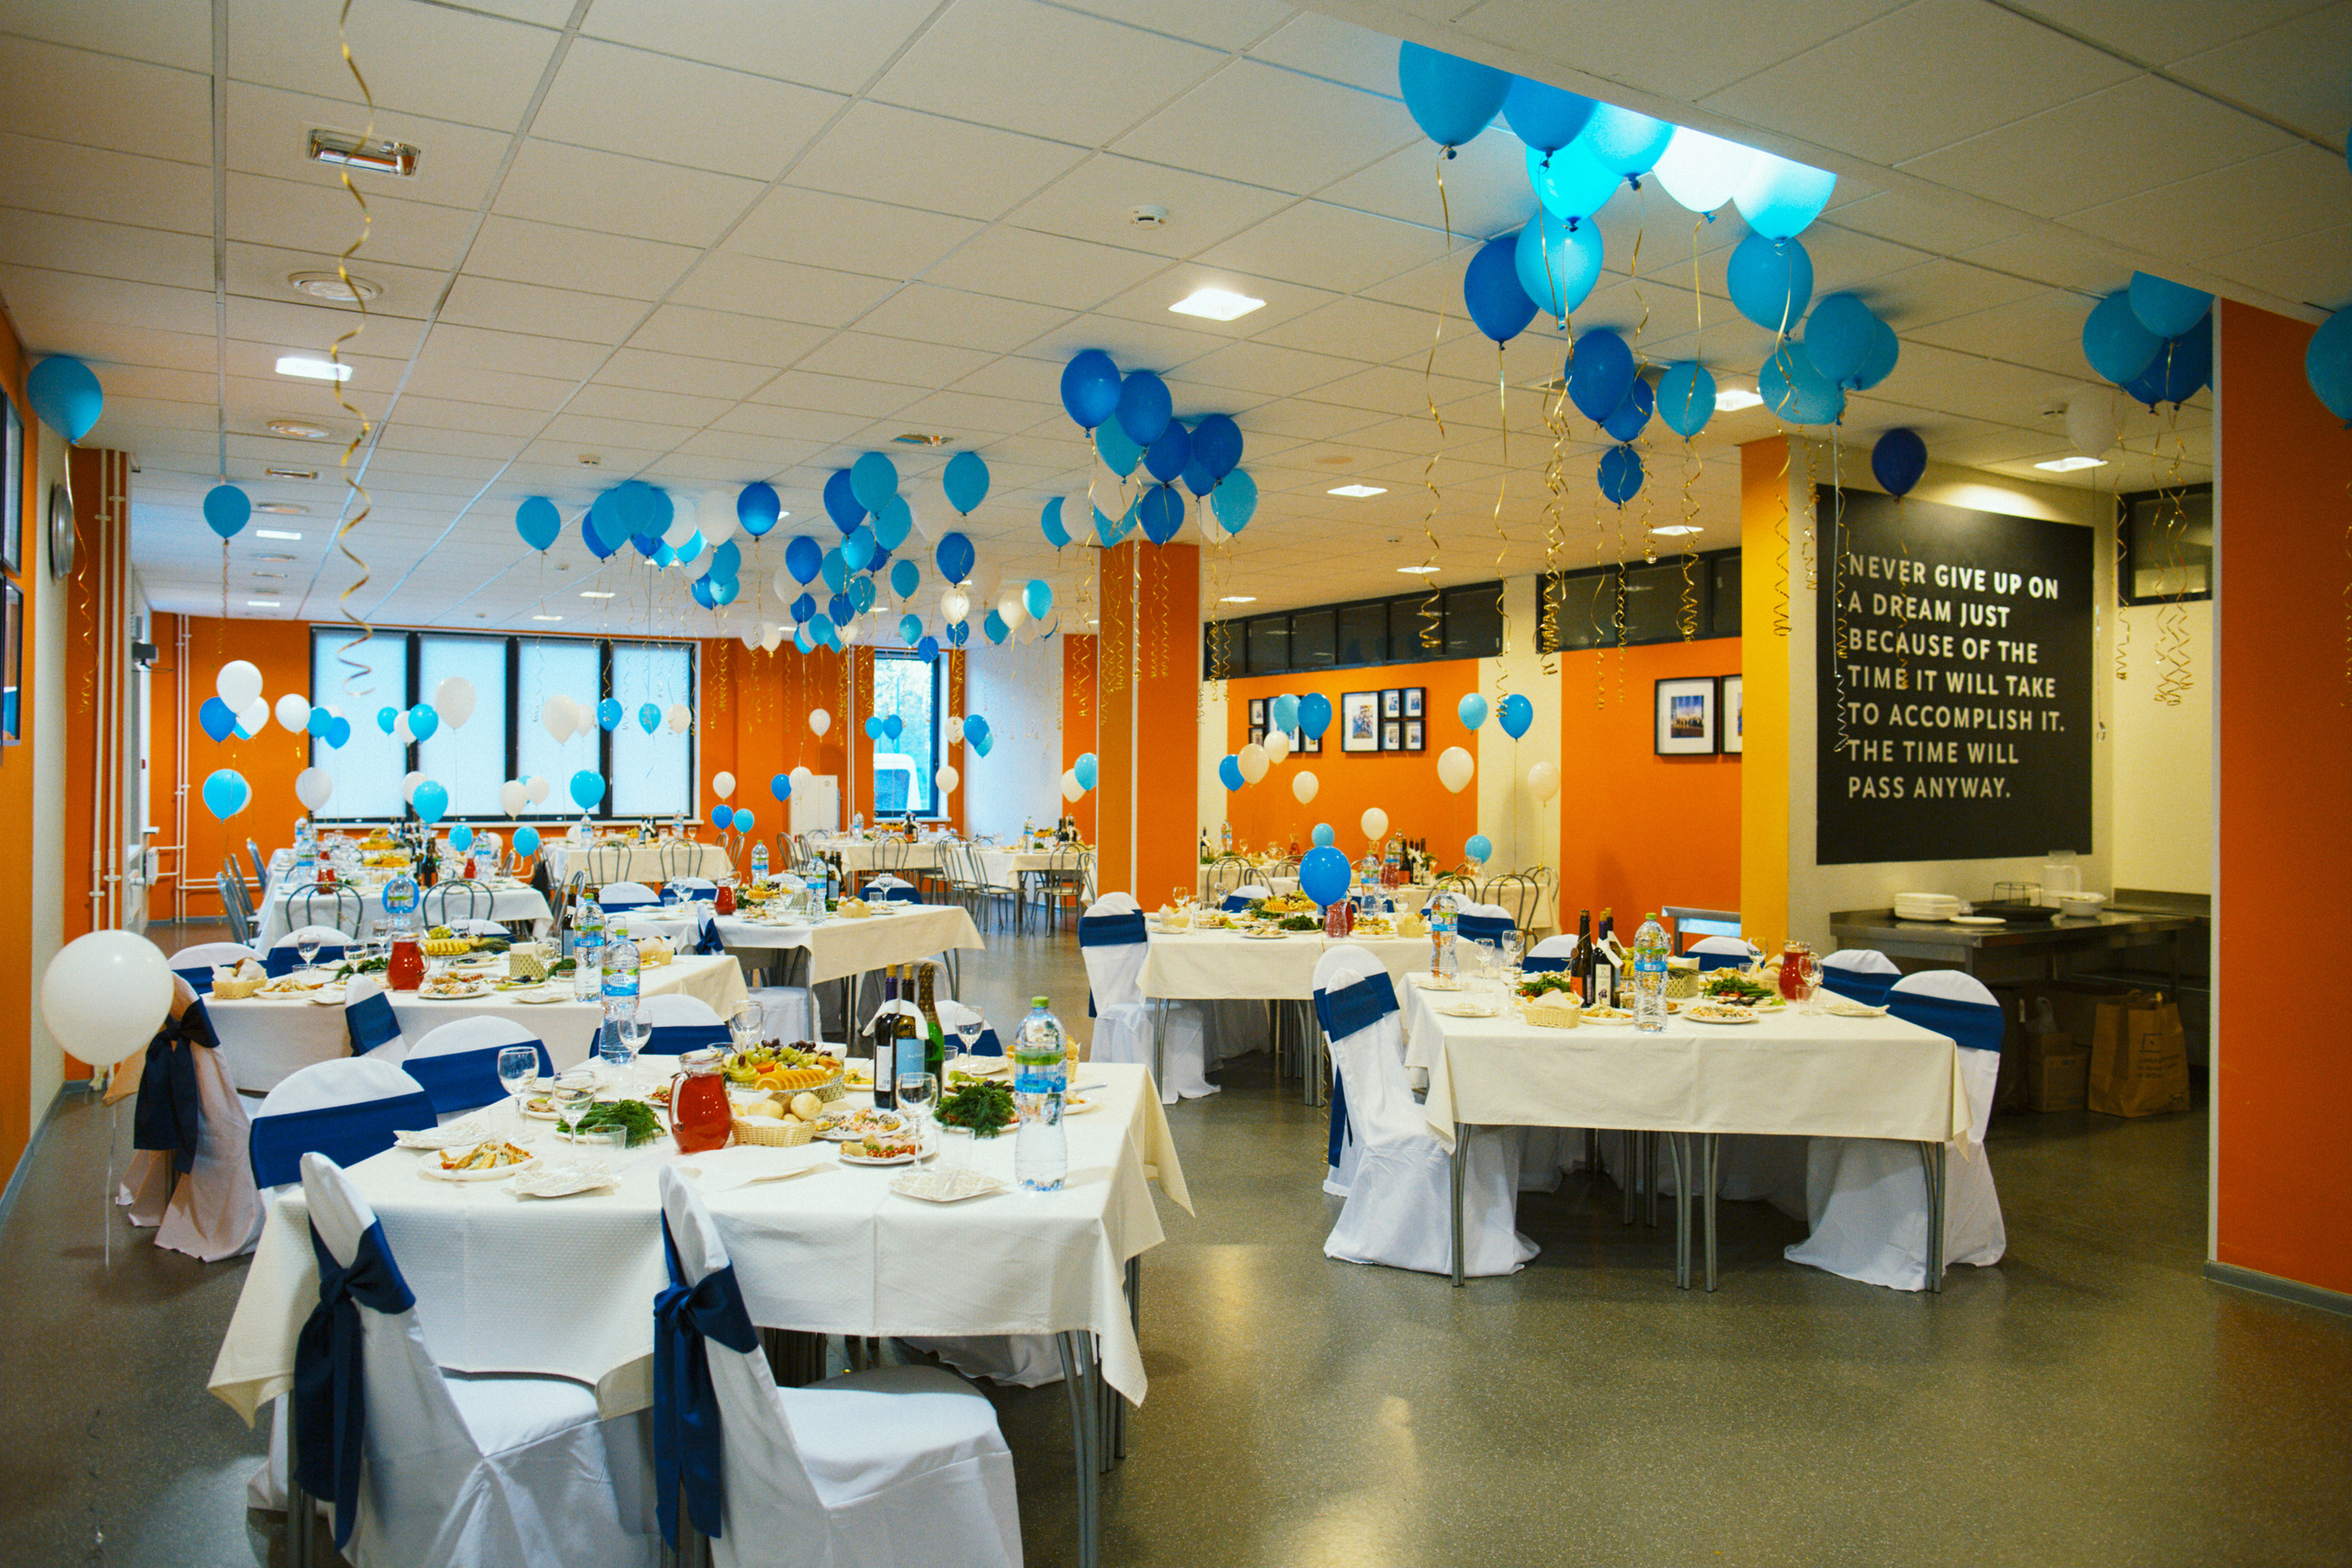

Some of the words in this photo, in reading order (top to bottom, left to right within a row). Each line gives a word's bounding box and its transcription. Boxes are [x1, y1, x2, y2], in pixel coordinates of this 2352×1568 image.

[1849, 553, 1927, 585] NEVER
[1934, 564, 1986, 592] GIVE
[1993, 571, 2022, 596] UP
[2028, 575, 2059, 601] ON
[1848, 590, 1862, 614] A
[1872, 592, 1951, 623] DREAM
[1959, 602, 2011, 628] JUST
[1849, 627, 1954, 659] BECAUSE
[1962, 637, 1992, 660] OF
[1996, 639, 2039, 665] THE
[1847, 664, 1907, 691] TIME
[1916, 669, 1938, 693] IT
[1945, 671, 1999, 696] WILL
[2005, 674, 2056, 699] TAKE
[1847, 701, 1880, 726] TO
[1888, 704, 2032, 732] ACCOMPLISH
[2041, 710, 2065, 732] IT.
[1848, 739, 1894, 763] THE
[1902, 740, 1959, 764] TIME
[1966, 742, 2019, 765] WILL
[1848, 775, 1905, 799] PASS
[1913, 776, 2011, 799] ANYWAY.
